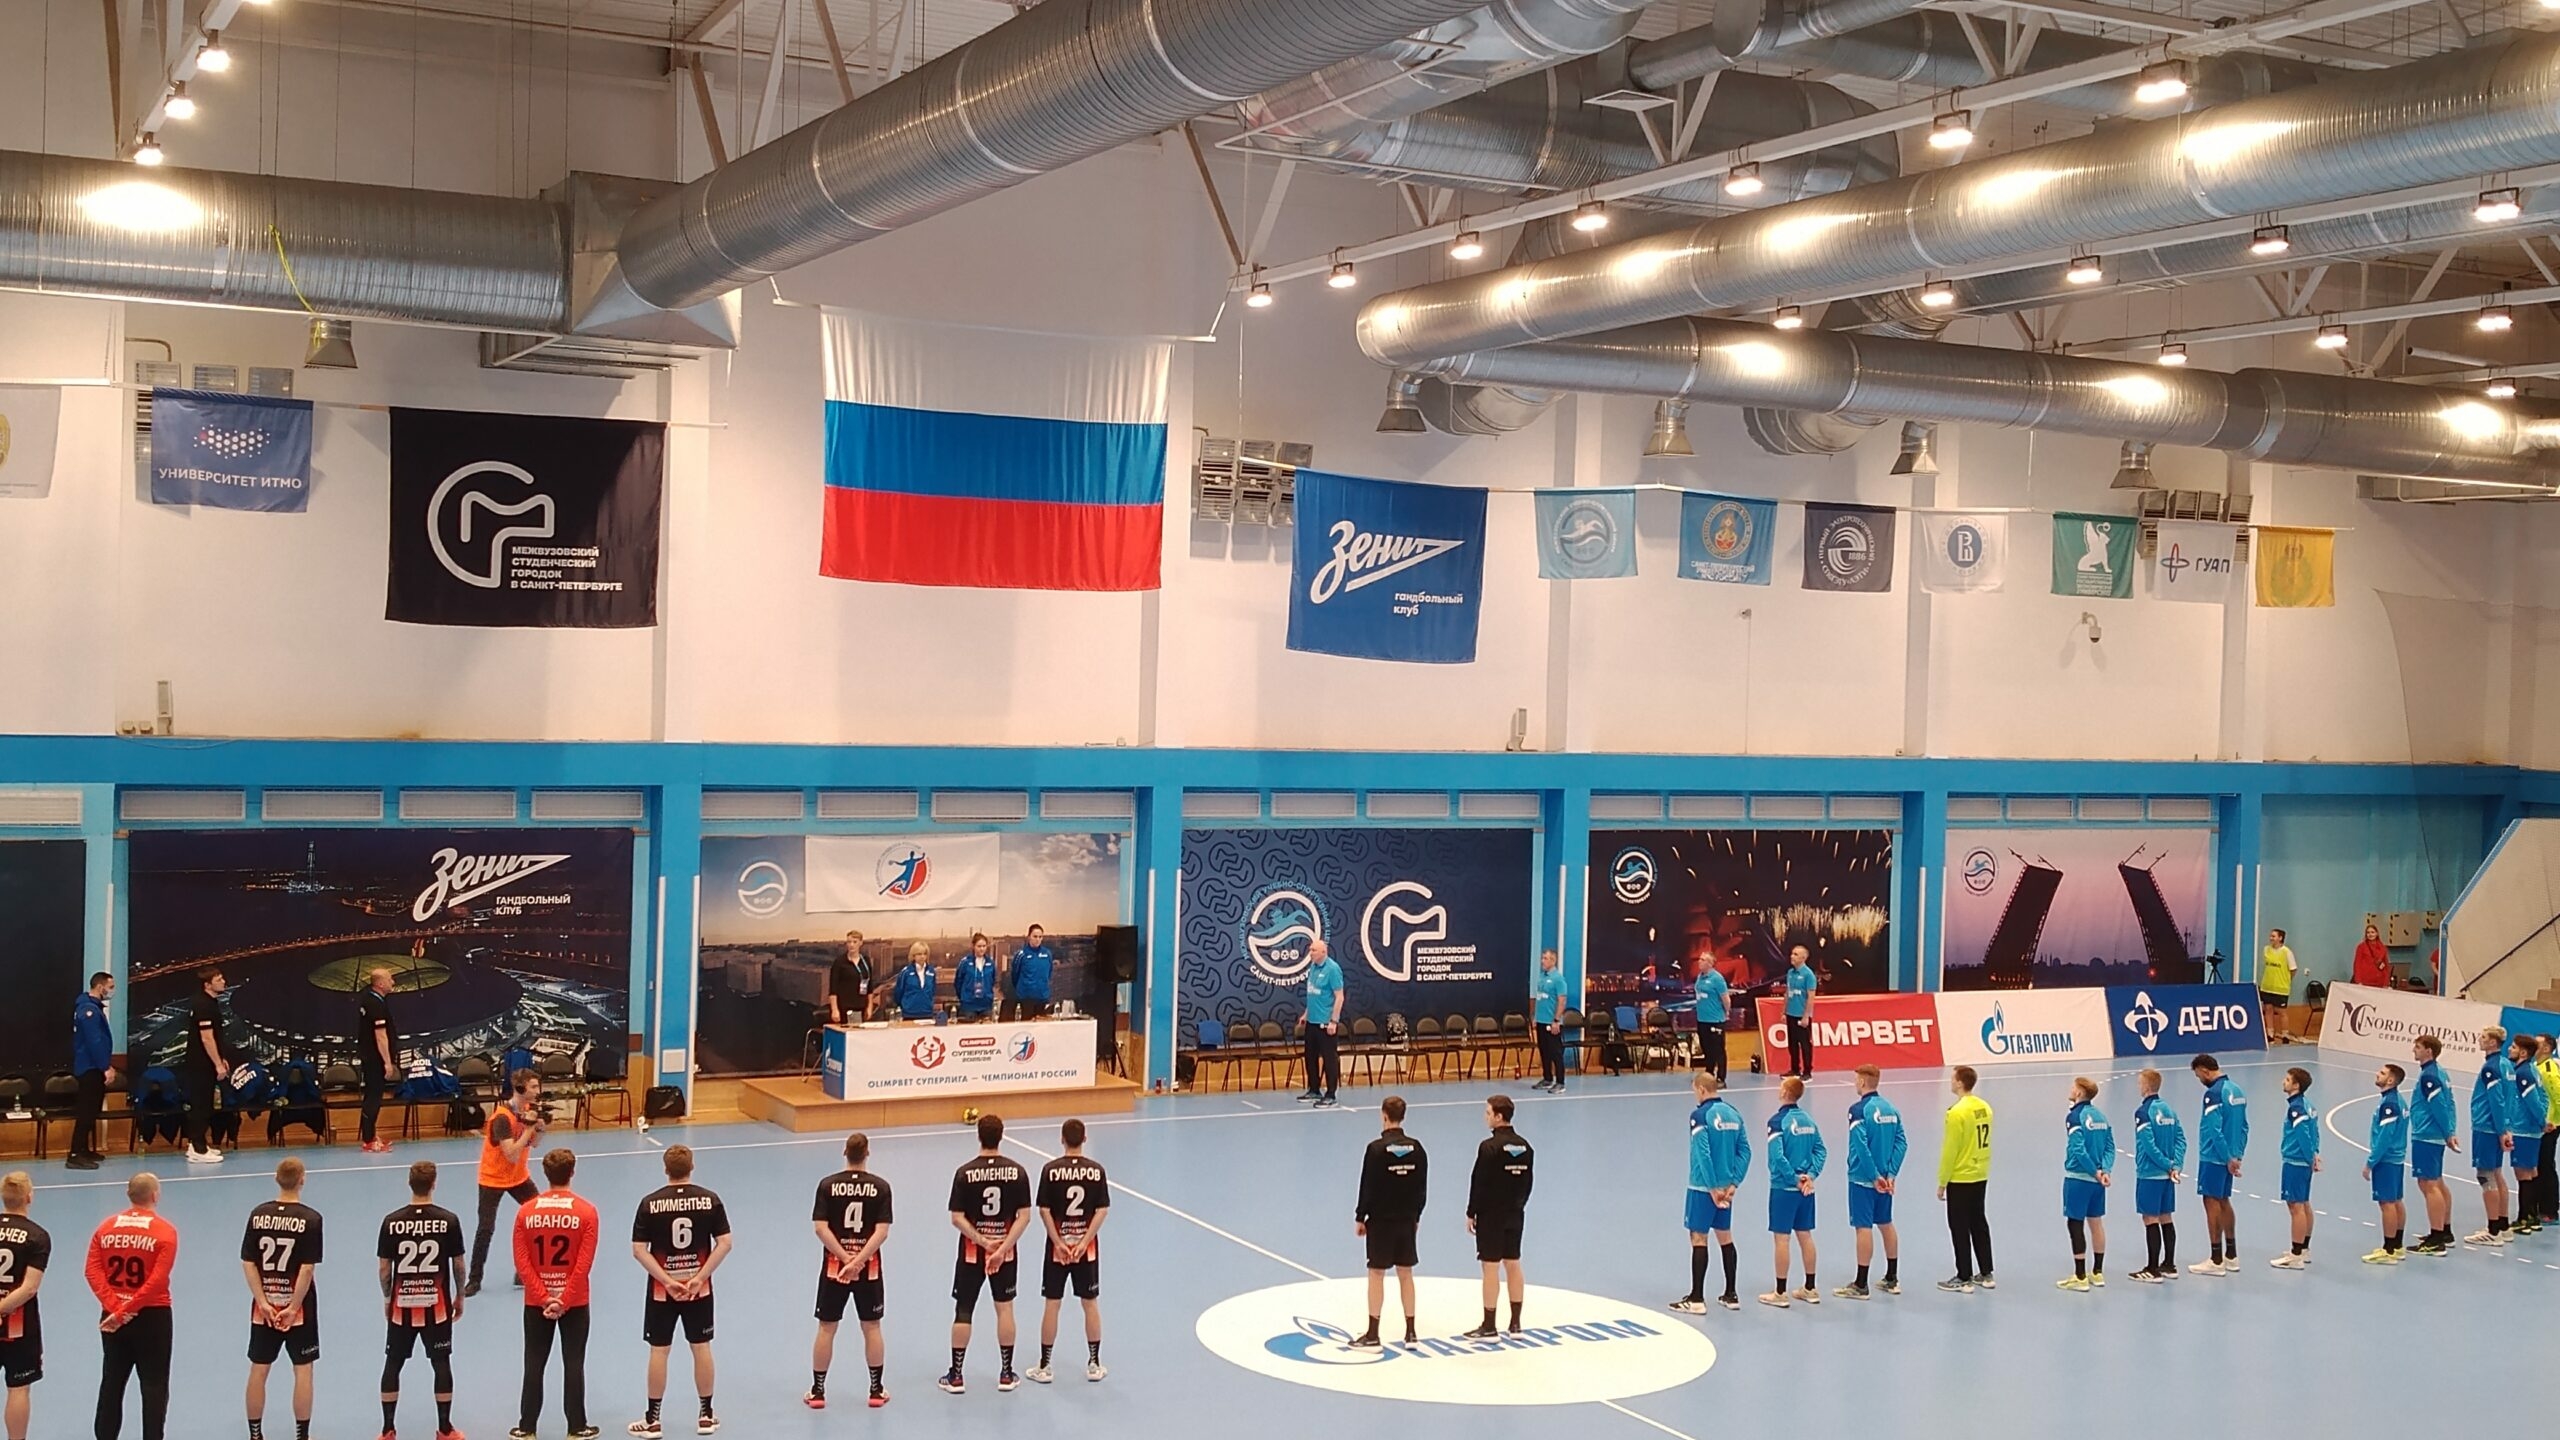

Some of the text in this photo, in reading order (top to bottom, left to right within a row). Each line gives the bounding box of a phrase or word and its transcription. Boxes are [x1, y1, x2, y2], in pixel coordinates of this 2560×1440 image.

[158, 468, 302, 489] УНИВЕРСИТЕТ ИТМО
[511, 545, 600, 557] МЕЖВУЗОВСКИЙ
[511, 557, 597, 568] СТУДЕНЧЕСКИЙ
[2195, 557, 2230, 573] ГУАП
[511, 569, 562, 579] ГОРОДОК
[510, 580, 623, 591] В САНКТ-ПЕТЕРБУРГЕ
[1394, 591, 1464, 604] гандбольный
[1393, 605, 1420, 617] клуб
[496, 893, 571, 906] ГАНДБОЛЬНЫЙ
[496, 906, 522, 916] КЛУБ
[1417, 944, 1477, 954] МЕЖВУЗОВСКИЙ
[1417, 954, 1474, 963] СТУДЕНЧЕСКИЙ
[1250, 965, 1310, 986] САНКТ-ПЕТЕРБУ
[1416, 964, 1452, 972] ГОРОДОК
[1423, 972, 1493, 981] САНКТ-ПЕТЕРБУРГЕ
[2178, 1005, 2248, 1036] ДЕЛО
[1768, 1019, 1934, 1049] OIMPBET
[2363, 1015, 2481, 1045] NORD COMPANY
[2378, 1033, 2414, 1043] СЕВЕРН
[2009, 1033, 2074, 1055] ГАЗПРОМ
[951, 1048, 1002, 1057] СУПЕРЛИГА
[868, 1078, 913, 1089] OLIMPBET
[916, 1075, 968, 1086] СУПЕРЛИГА
[981, 1071, 1038, 1082] ЧЕМПИОНАТ
[1041, 1069, 1078, 1079] РОССИИ
[1976, 1124, 1989, 1149] 12
[966, 1166, 1018, 1183] ТЮМЕНЦЕВ
[1050, 1167, 1101, 1181] ГУМАРОВ
[831, 1182, 878, 1198] КОВАЛЬ
[649, 1196, 713, 1214] КЛИМЕНТЬЕВ
[982, 1186, 1001, 1216] 3
[1066, 1185, 1085, 1216] 2
[253, 1214, 306, 1233] ПАВЛИКОВ
[525, 1214, 580, 1230] ИВАНОВ
[844, 1201, 863, 1233] 4
[389, 1219, 448, 1236] ГОРДЕЕВ
[671, 1217, 693, 1249] 6
[101, 1234, 157, 1252] КРЕВЧИК
[534, 1235, 570, 1267] 12
[259, 1236, 296, 1272] 27
[397, 1240, 439, 1274] 22
[667, 1253, 697, 1262] ДИНАМО
[107, 1255, 146, 1288] 29
[263, 1284, 293, 1293] СТРАХАНЬ
[398, 1286, 438, 1294] АСТРАХАНЬ
